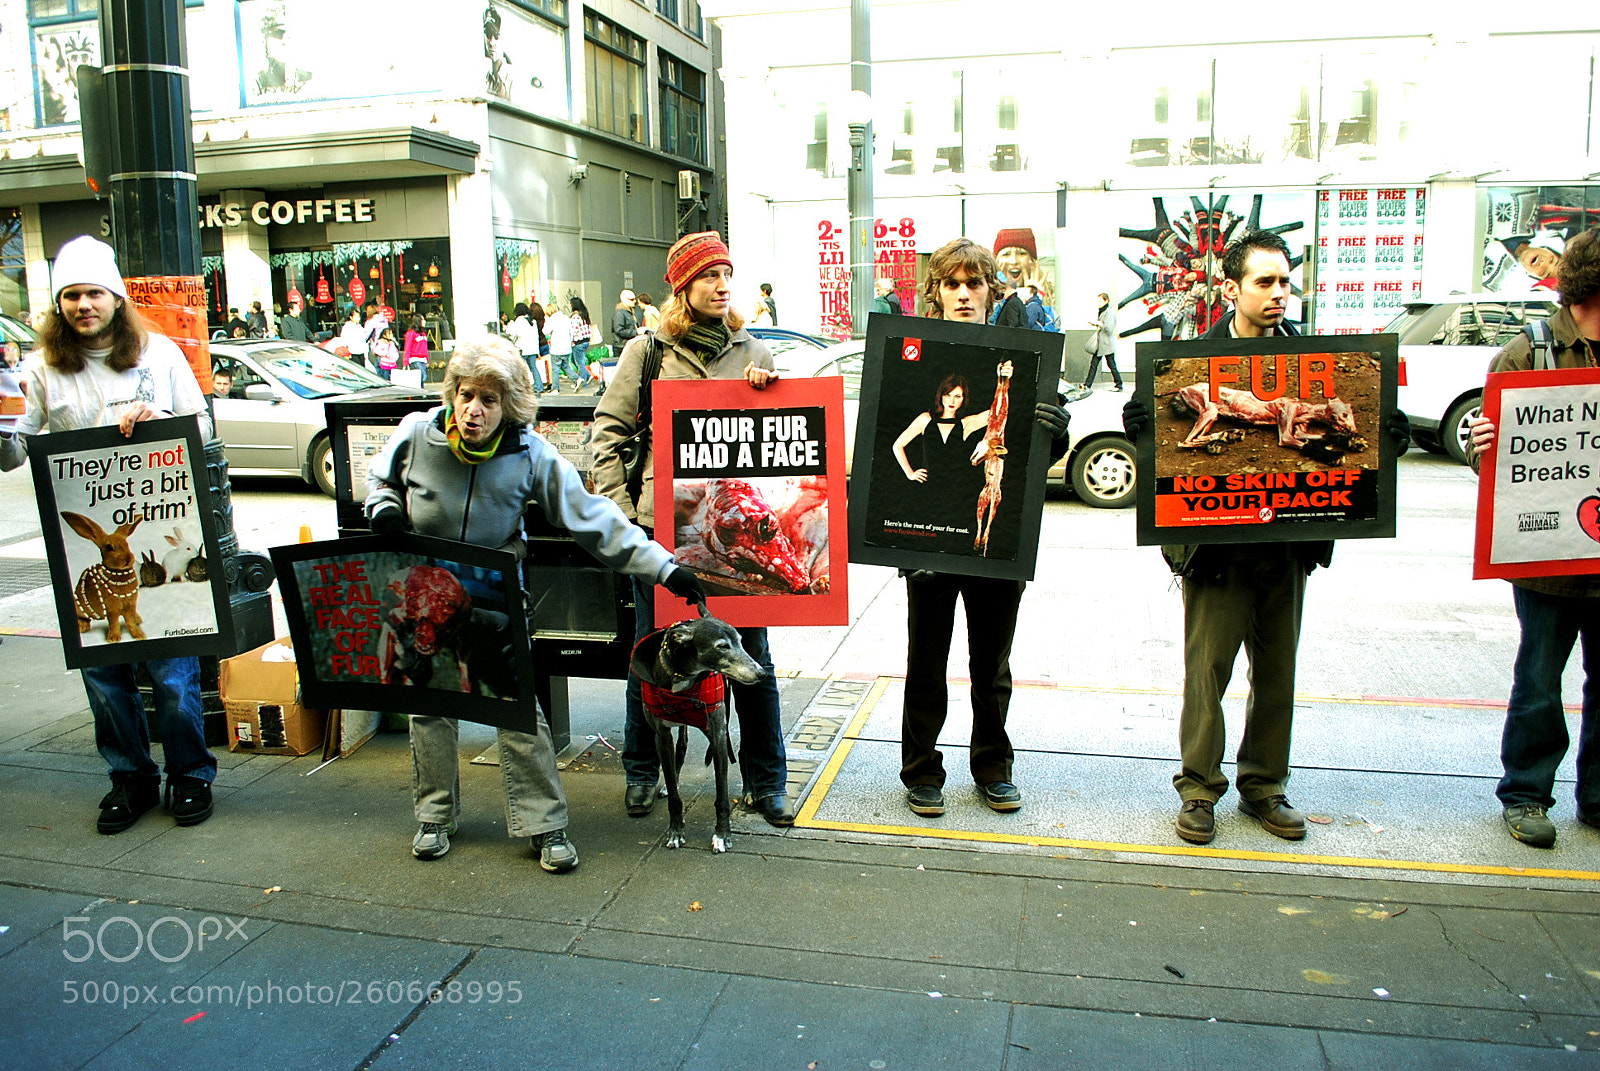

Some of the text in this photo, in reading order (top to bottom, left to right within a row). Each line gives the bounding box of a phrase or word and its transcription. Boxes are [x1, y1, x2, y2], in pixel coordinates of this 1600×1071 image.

[1339, 192, 1367, 201] FREE
[1377, 190, 1406, 200] FREE
[251, 199, 372, 225] COFFEE
[1338, 238, 1366, 246] FREE
[1376, 237, 1404, 245] FREE
[881, 265, 916, 279] MODEST
[1336, 283, 1364, 291] FREE
[1374, 283, 1402, 291] FREE
[1208, 353, 1336, 402] FUR
[1516, 404, 1574, 426] What
[363, 432, 377, 441] The
[690, 416, 808, 442] YOUR FUR
[560, 442, 579, 450] Times
[680, 440, 819, 469] HAD A FACE
[1510, 436, 1567, 454] Does
[148, 445, 184, 468] not
[1173, 470, 1362, 492] NO SKIN OFF
[1511, 461, 1590, 483] Breaks
[141, 479, 154, 496] a
[161, 470, 188, 493] bit
[1183, 490, 1352, 511] YOUR BACK
[112, 502, 136, 525] of
[1518, 518, 1559, 528] ANIMALS
[313, 561, 368, 584] THE
[309, 584, 380, 607] REAL
[316, 608, 381, 629] FACE
[335, 631, 369, 652] OF
[332, 655, 380, 676] FUR
